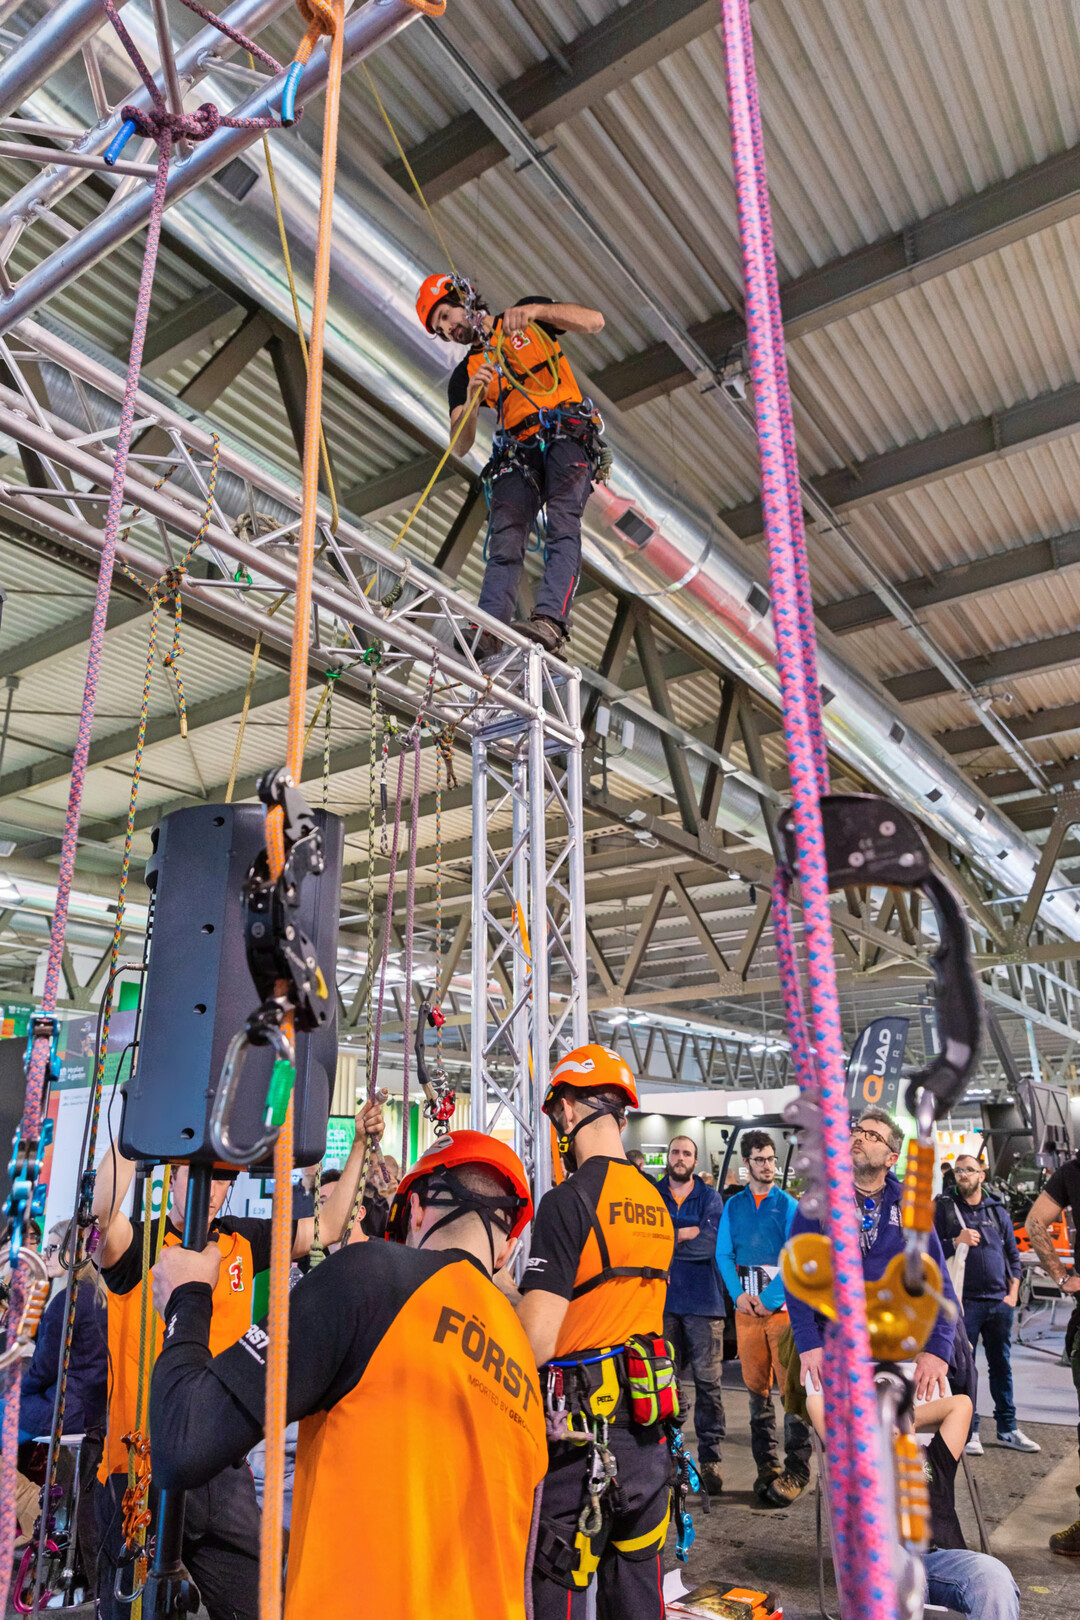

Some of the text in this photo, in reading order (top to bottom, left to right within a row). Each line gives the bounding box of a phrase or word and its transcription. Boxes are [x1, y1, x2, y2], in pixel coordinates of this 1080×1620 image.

[863, 1029, 891, 1103] QUAD
[609, 1197, 667, 1227] FÖRST
[433, 1306, 539, 1412] FÖRST
[468, 1374, 499, 1406] IMPORTED
